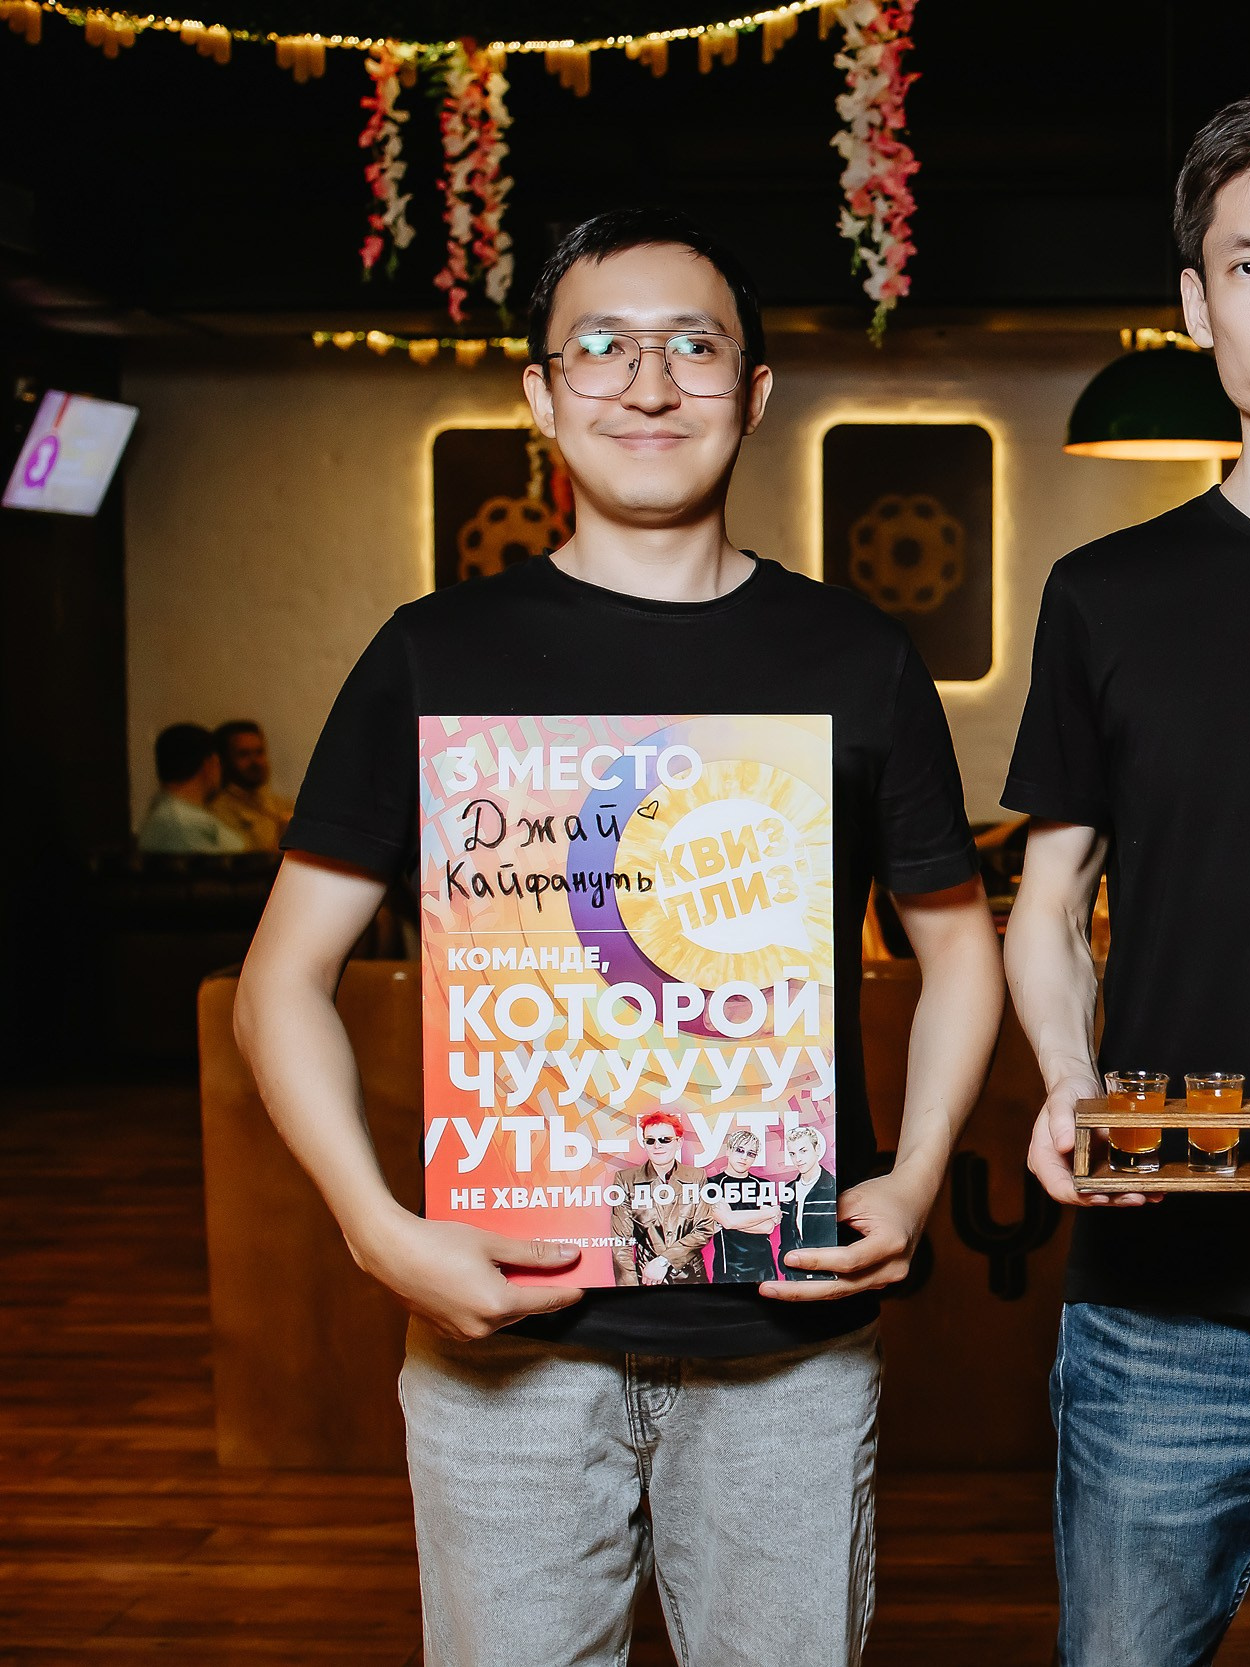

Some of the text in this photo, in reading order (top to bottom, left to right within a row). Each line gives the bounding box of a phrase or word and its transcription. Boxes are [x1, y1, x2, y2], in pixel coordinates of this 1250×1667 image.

[446, 744, 702, 792] 3 МЕСТО
[461, 798, 621, 852] Джай
[446, 859, 653, 914] Кайфануть
[447, 946, 610, 974] КОМАНДЕ,
[448, 965, 820, 1042] КОТОРОЙ
[451, 1181, 801, 1210] НЕ ХВАТИЛО ДО ПОБЕДЫ
[591, 1237, 626, 1248] ХИТЫ
